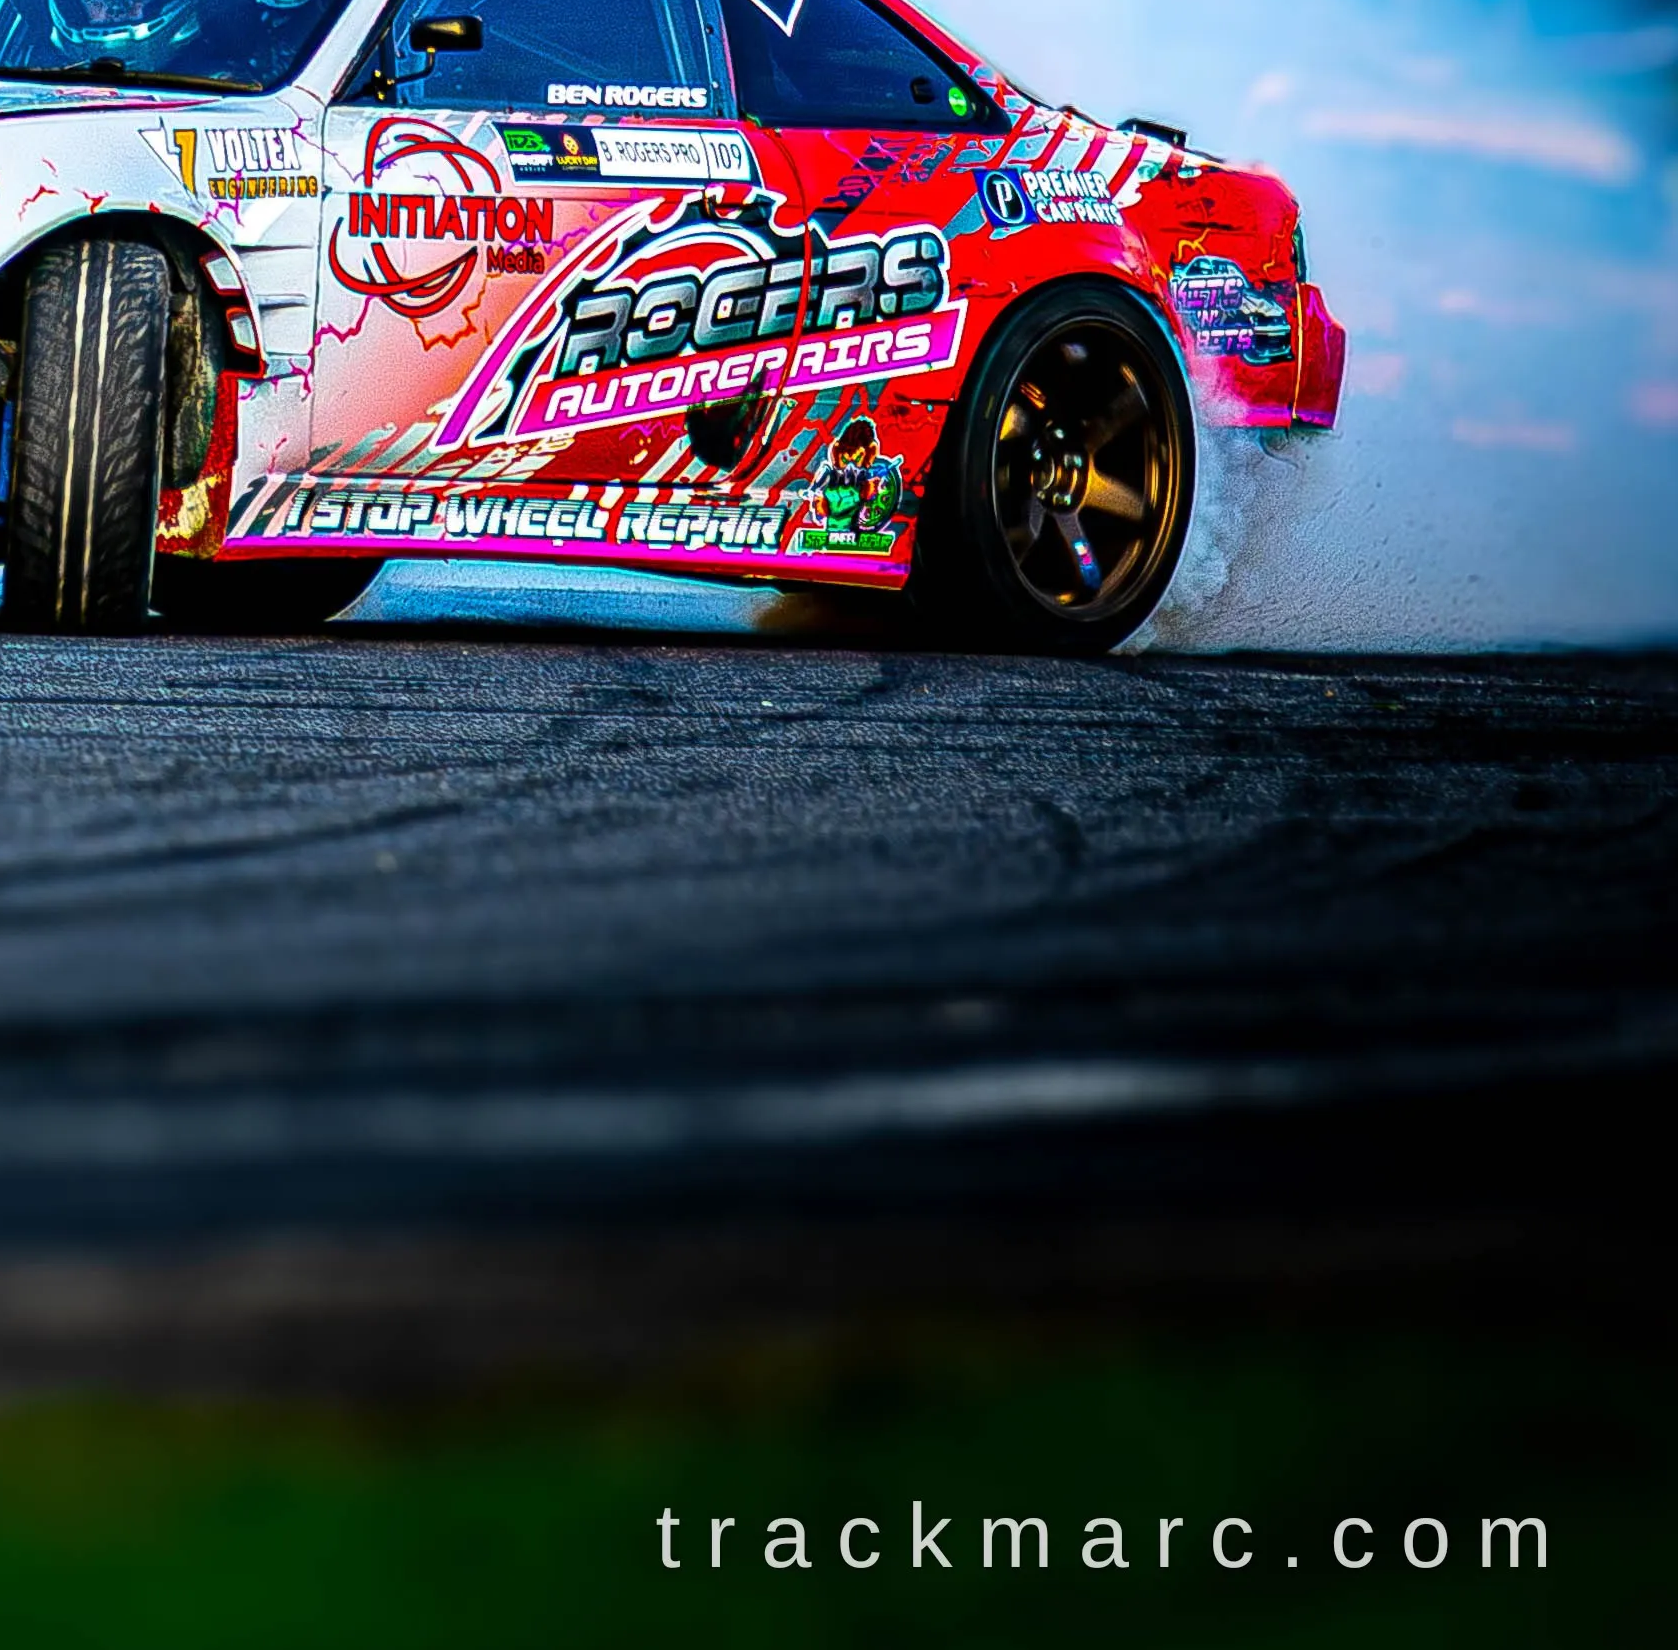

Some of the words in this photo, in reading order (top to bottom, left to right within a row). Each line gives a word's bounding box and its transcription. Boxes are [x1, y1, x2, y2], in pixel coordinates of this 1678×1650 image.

[547, 84, 602, 105] BEN
[604, 85, 708, 108] ROGERS
[205, 128, 302, 172] VOLTEX
[619, 141, 671, 165] ROGERS
[674, 142, 701, 165] PRO
[709, 142, 742, 171] 109
[208, 176, 319, 200] ENGINEERING
[993, 181, 1013, 218] P
[1021, 171, 1112, 199] PREMIER
[1035, 201, 1077, 223] CAR
[1074, 202, 1124, 227] PARTS
[486, 245, 545, 274] Media
[559, 230, 945, 378] ROGERS
[543, 322, 932, 423] AUTOREPAIRS
[311, 492, 435, 534] STOP
[445, 494, 609, 540] WHEEL
[617, 500, 785, 547] REPAIR
